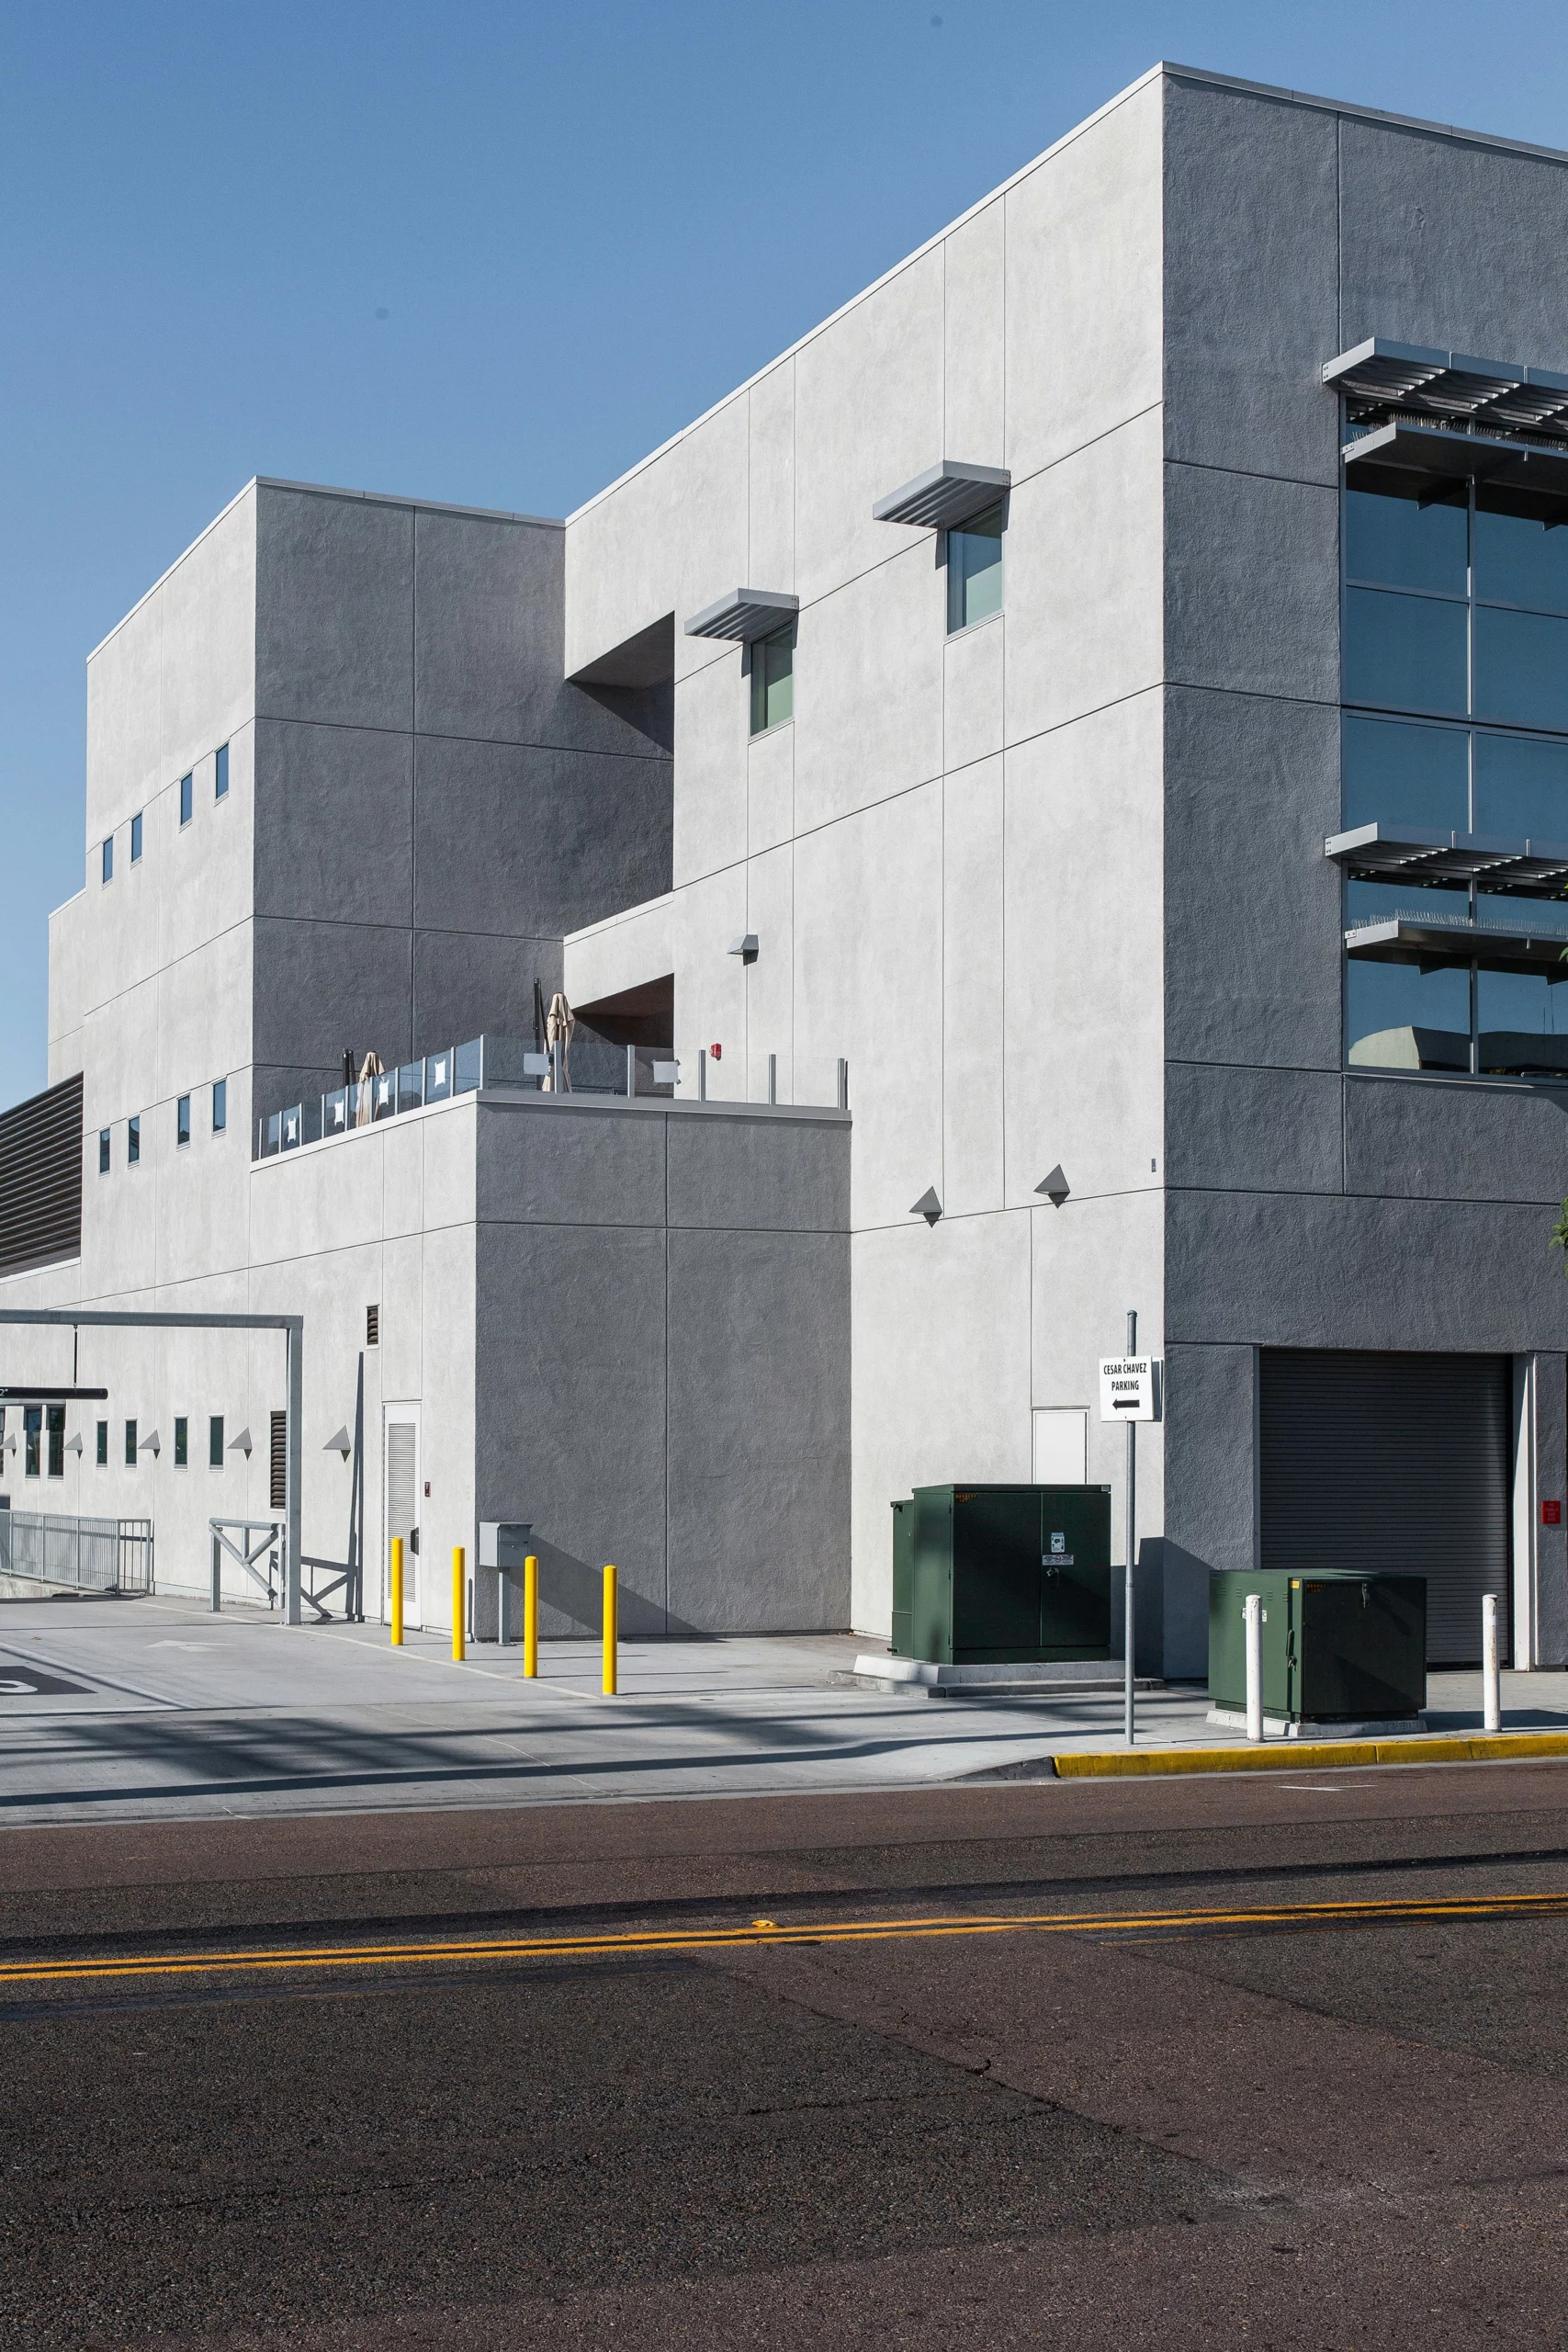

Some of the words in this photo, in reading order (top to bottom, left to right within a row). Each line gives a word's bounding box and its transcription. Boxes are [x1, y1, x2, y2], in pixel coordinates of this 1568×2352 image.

[1103, 1364, 1122, 1374] CESAR
[1122, 1363, 1146, 1374] CHAVEZ
[1111, 1380, 1139, 1391] PARKING
